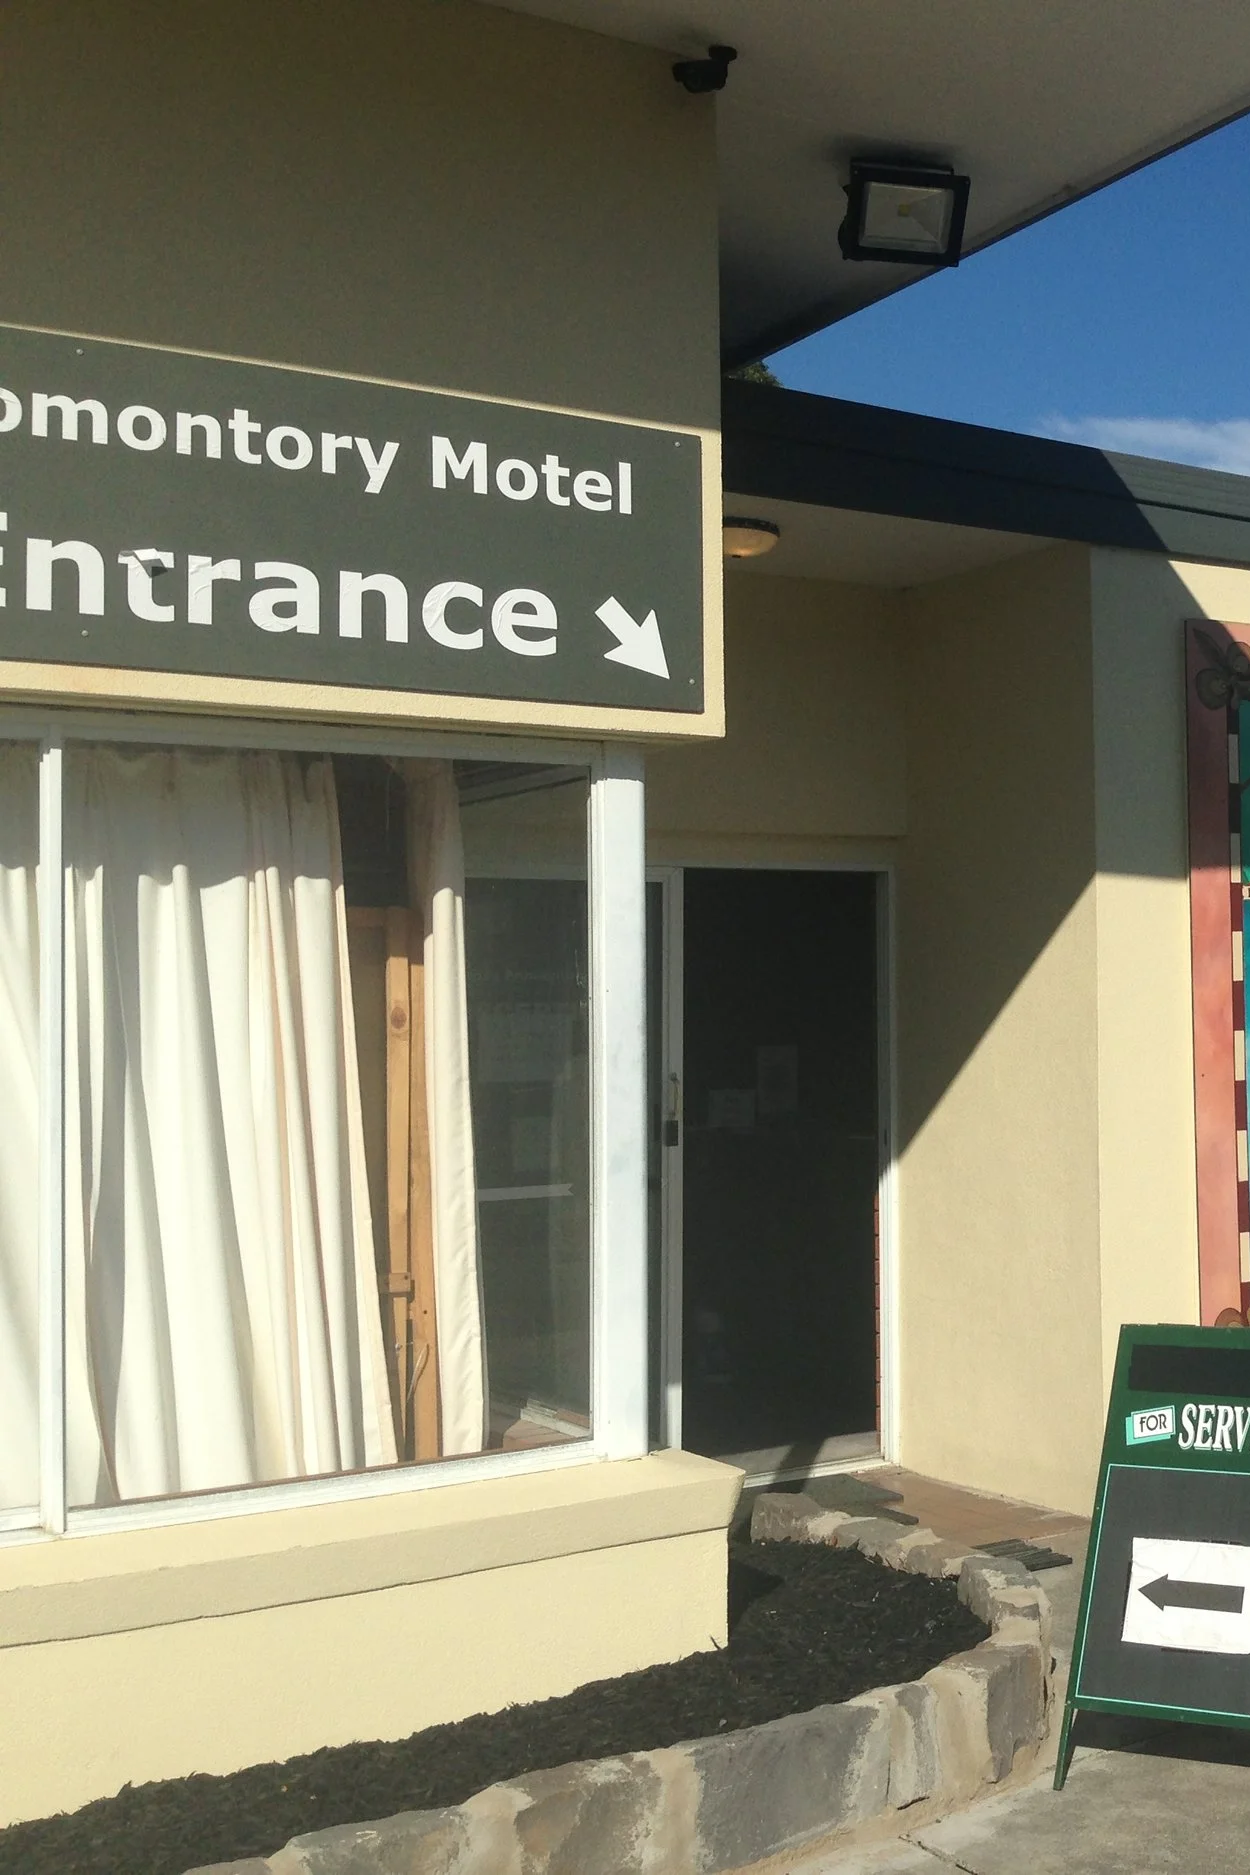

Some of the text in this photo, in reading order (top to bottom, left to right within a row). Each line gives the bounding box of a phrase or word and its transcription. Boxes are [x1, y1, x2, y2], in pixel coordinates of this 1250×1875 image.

[431, 435, 633, 515] Motel
[0, 512, 559, 657] ntrance
[1138, 1413, 1168, 1433] FOR
